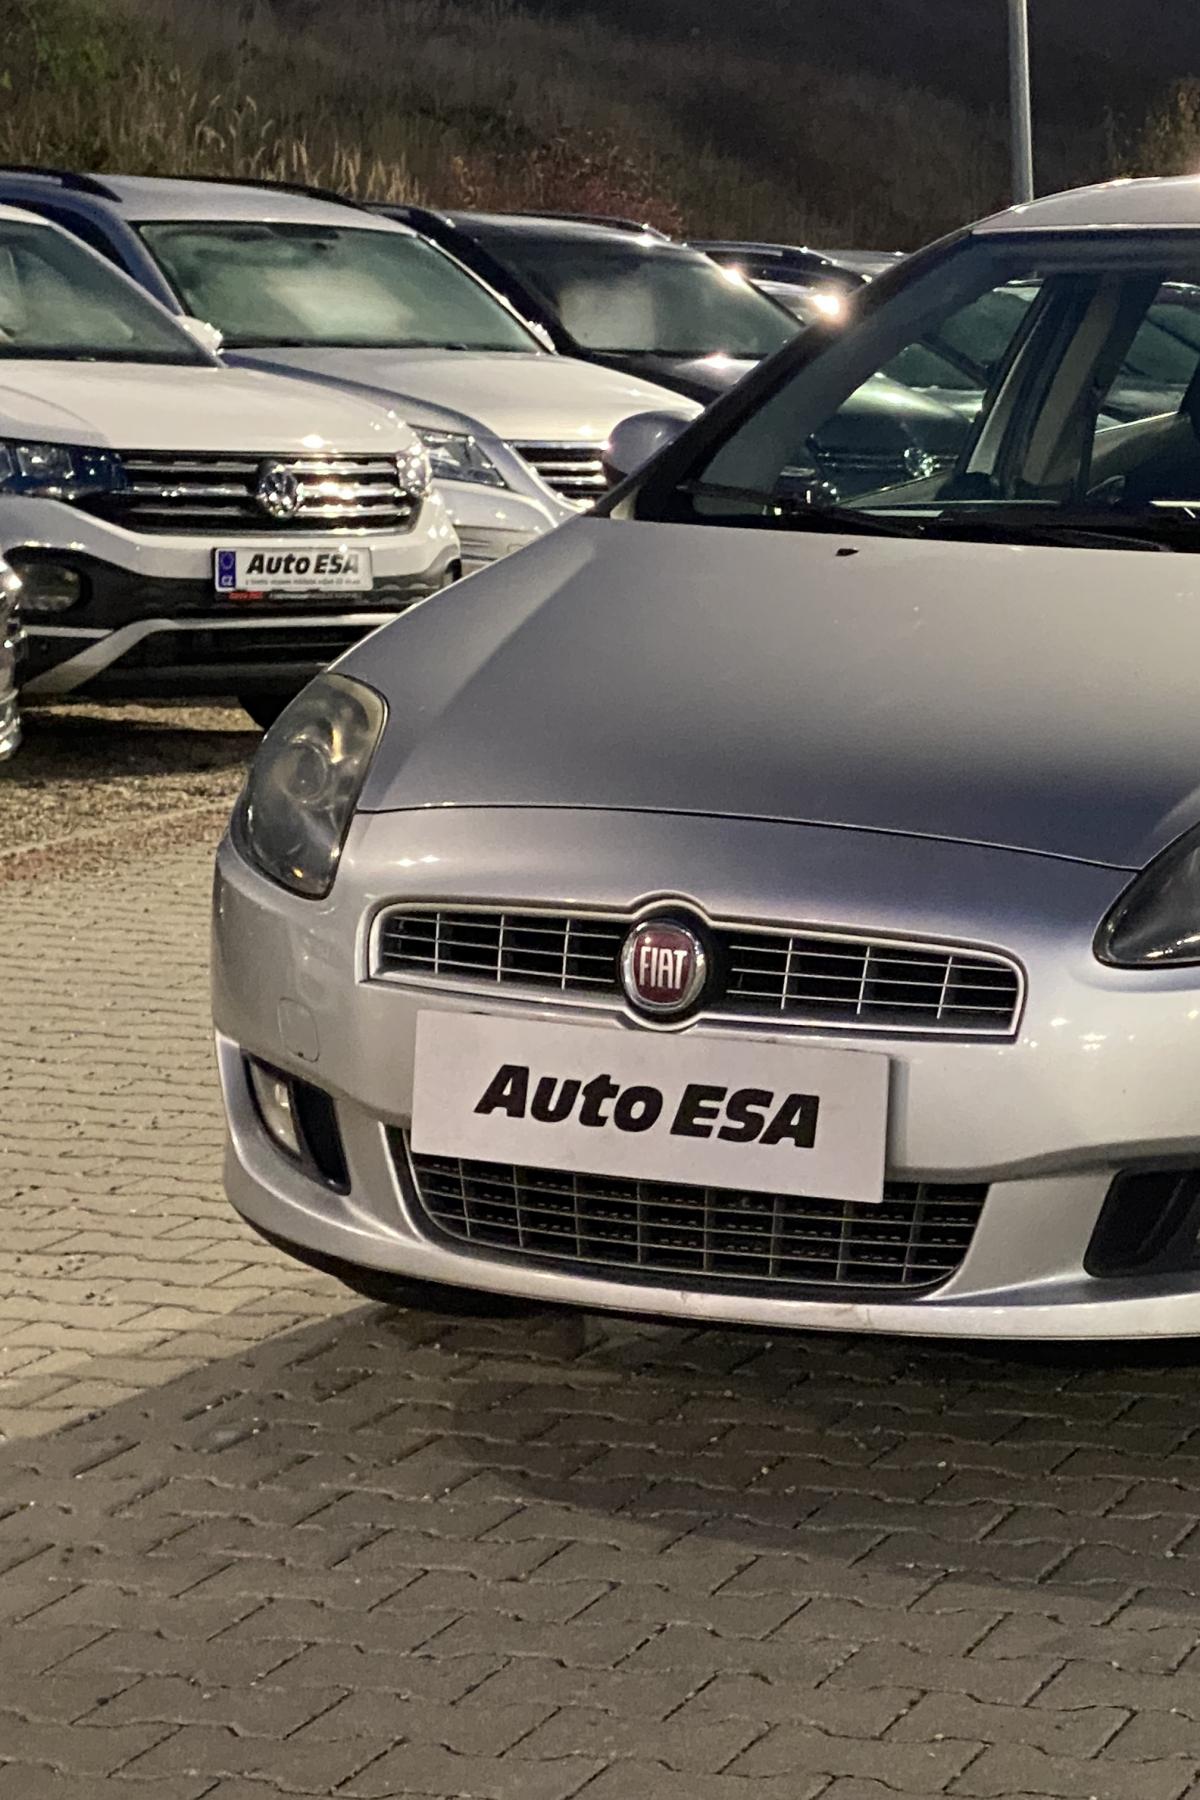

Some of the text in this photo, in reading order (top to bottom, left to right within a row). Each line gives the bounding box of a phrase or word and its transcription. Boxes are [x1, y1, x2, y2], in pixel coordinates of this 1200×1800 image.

[246, 554, 359, 575] Auto ESA
[639, 945, 688, 990] FIAT
[473, 1063, 821, 1149] Auto ESA
